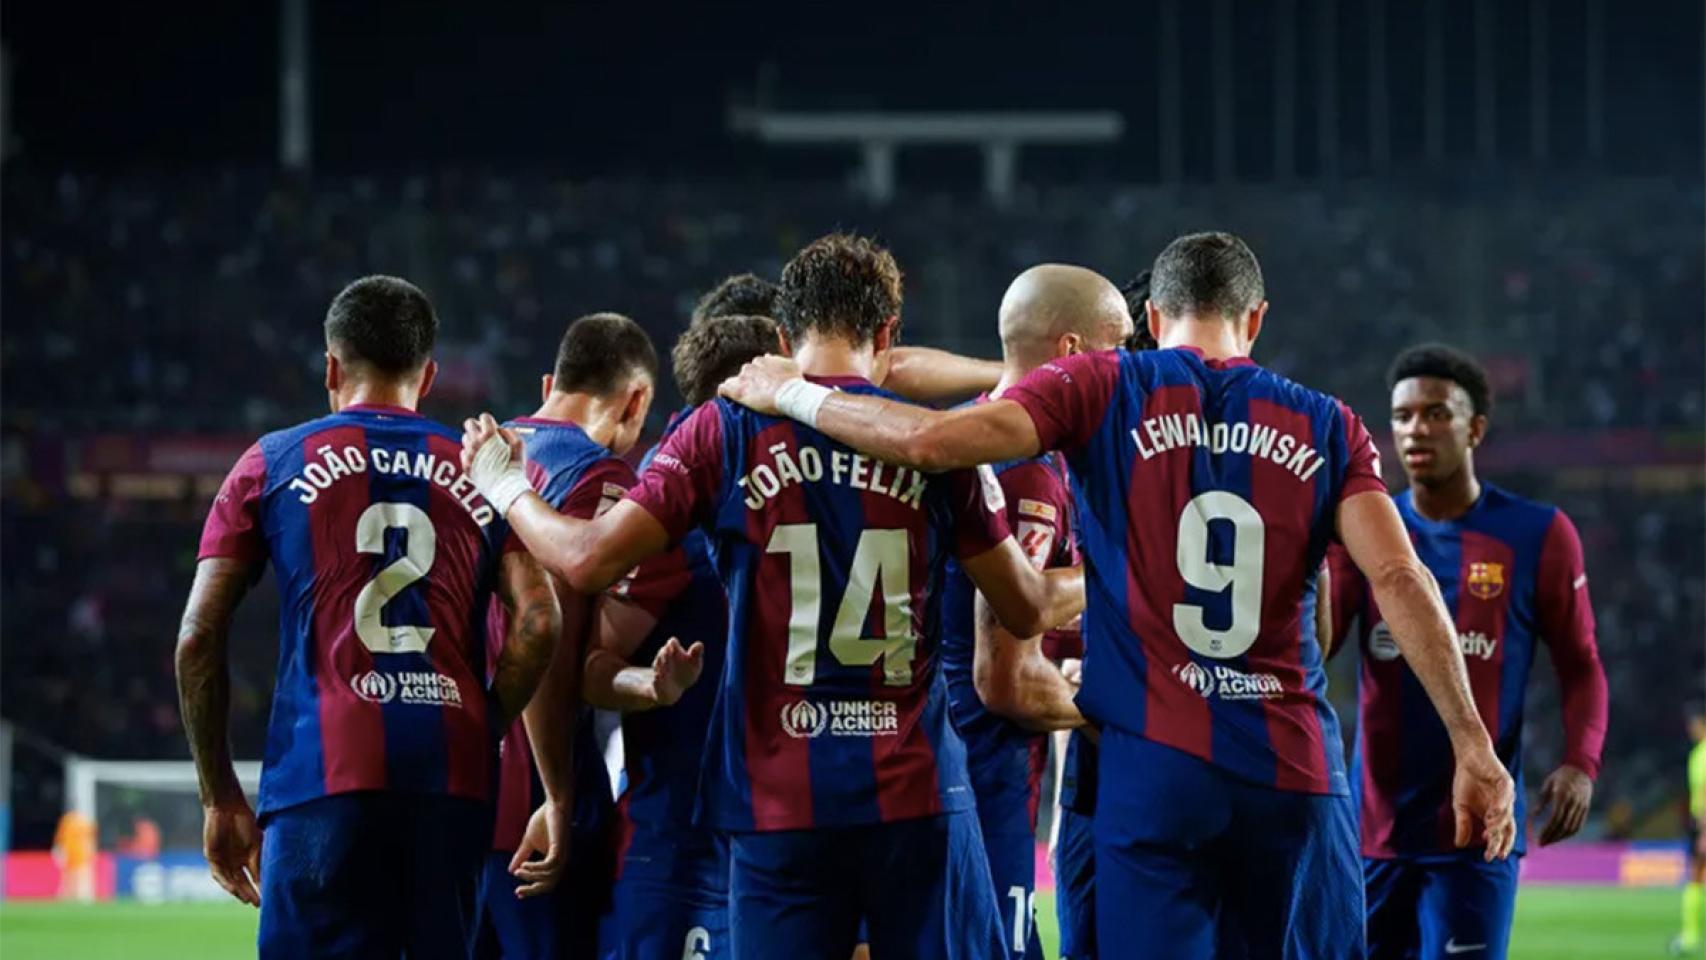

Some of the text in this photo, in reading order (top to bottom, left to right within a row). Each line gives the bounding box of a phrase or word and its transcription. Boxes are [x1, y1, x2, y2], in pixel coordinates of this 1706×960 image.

[289, 444, 494, 526] JOÃO CANCELO
[738, 441, 928, 511] JOÃO FELIX
[354, 502, 436, 653] 2
[1172, 490, 1265, 658] 9
[765, 522, 917, 686] 14
[397, 672, 458, 687] UNHCR
[400, 686, 462, 703] ACNUR
[1217, 677, 1284, 694] ACNUR
[830, 701, 897, 715] UNHCR
[831, 716, 898, 730] ACNUR
